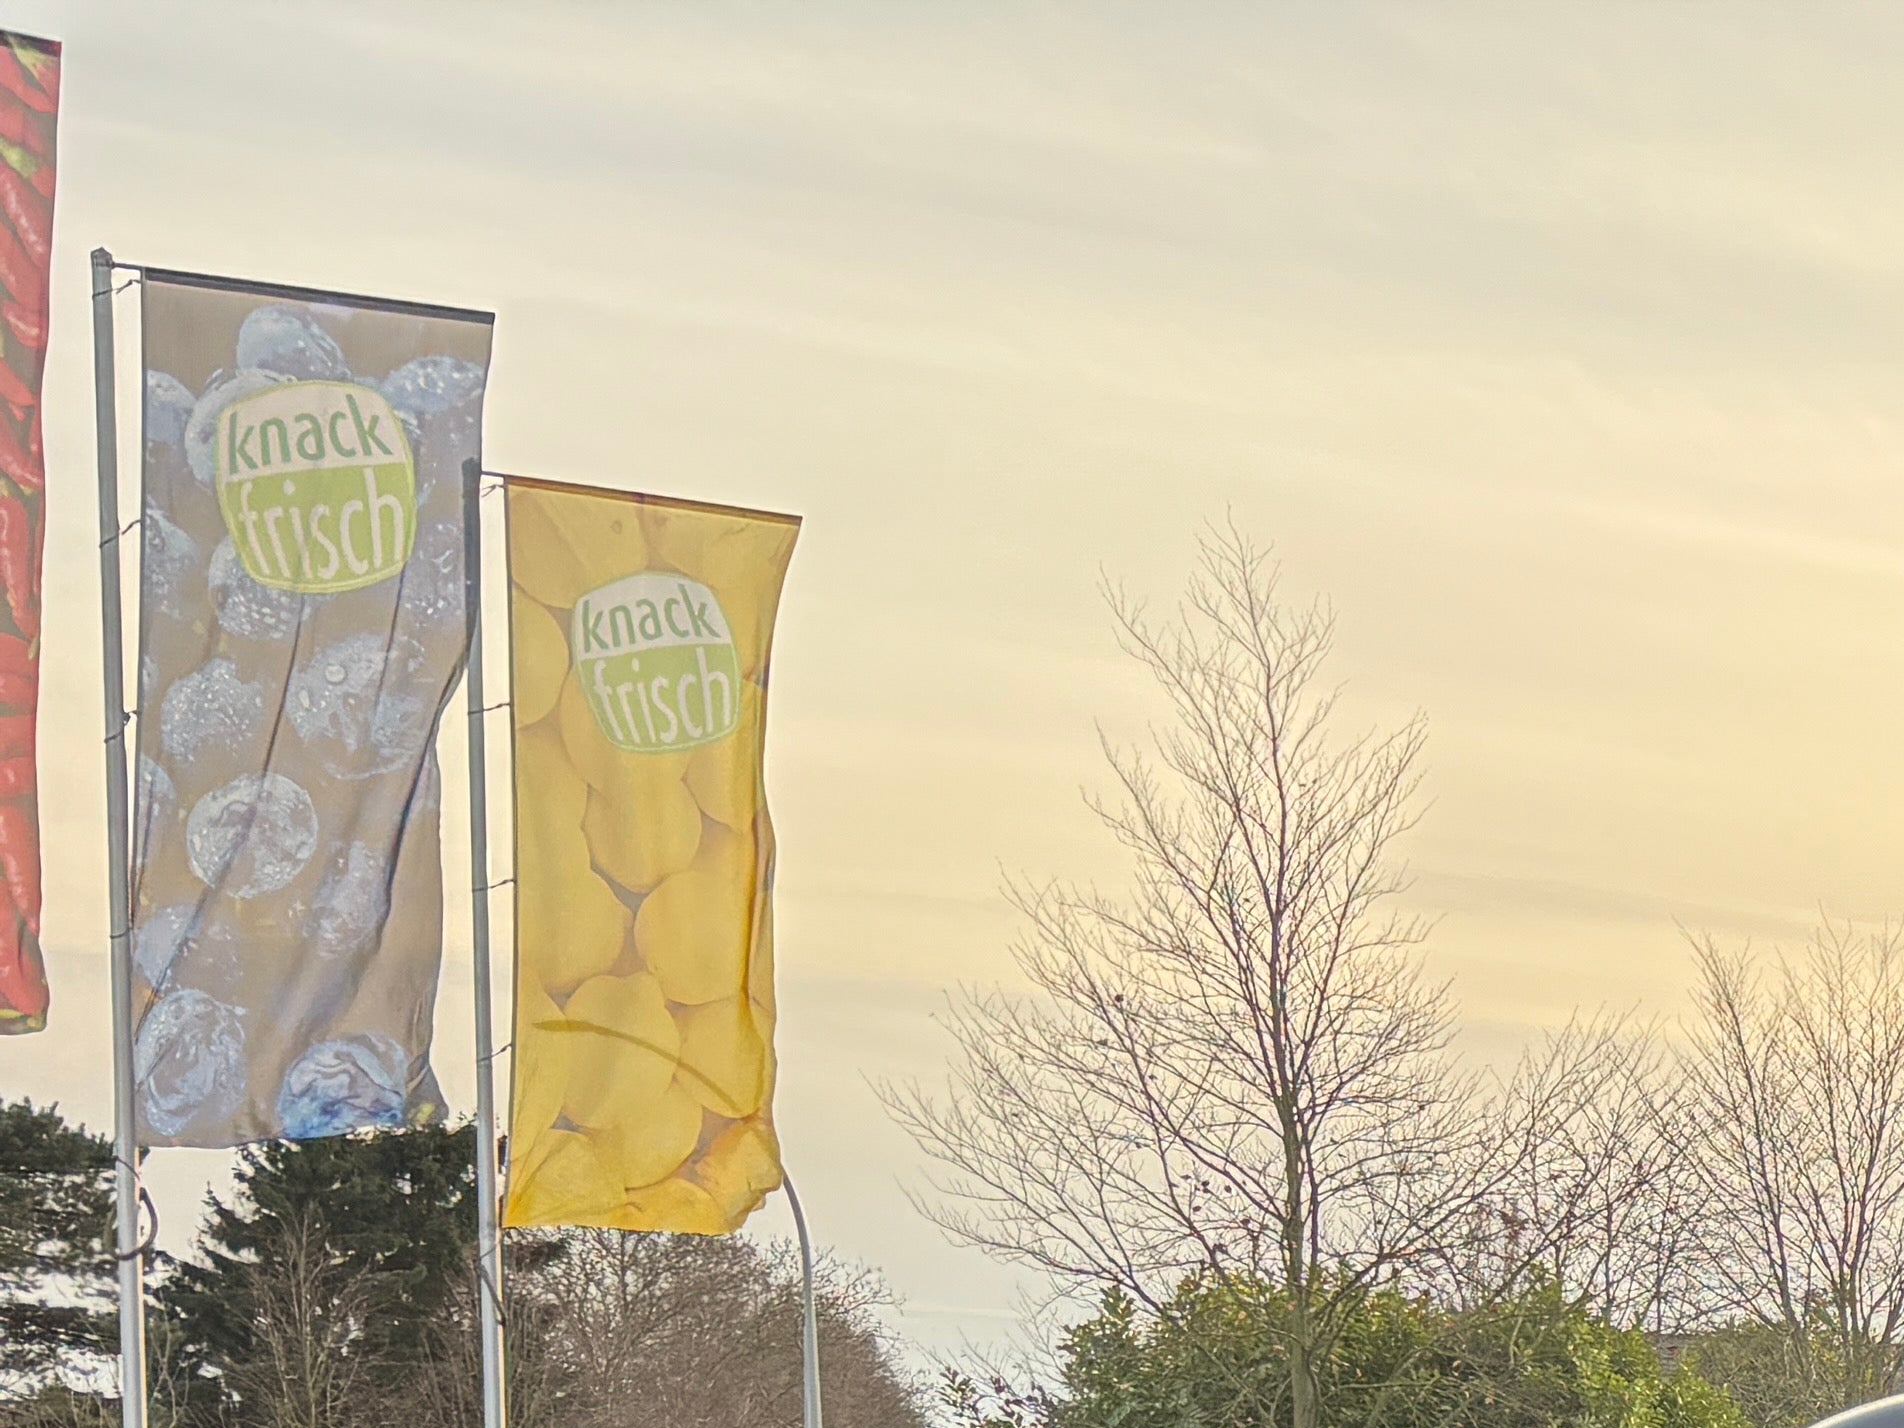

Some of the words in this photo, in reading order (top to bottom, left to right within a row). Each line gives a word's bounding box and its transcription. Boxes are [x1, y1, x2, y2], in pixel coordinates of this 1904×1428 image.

[228, 393, 394, 476] knack
[239, 467, 404, 579] frisch
[582, 583, 721, 653] knack
[594, 646, 731, 743] frisch
